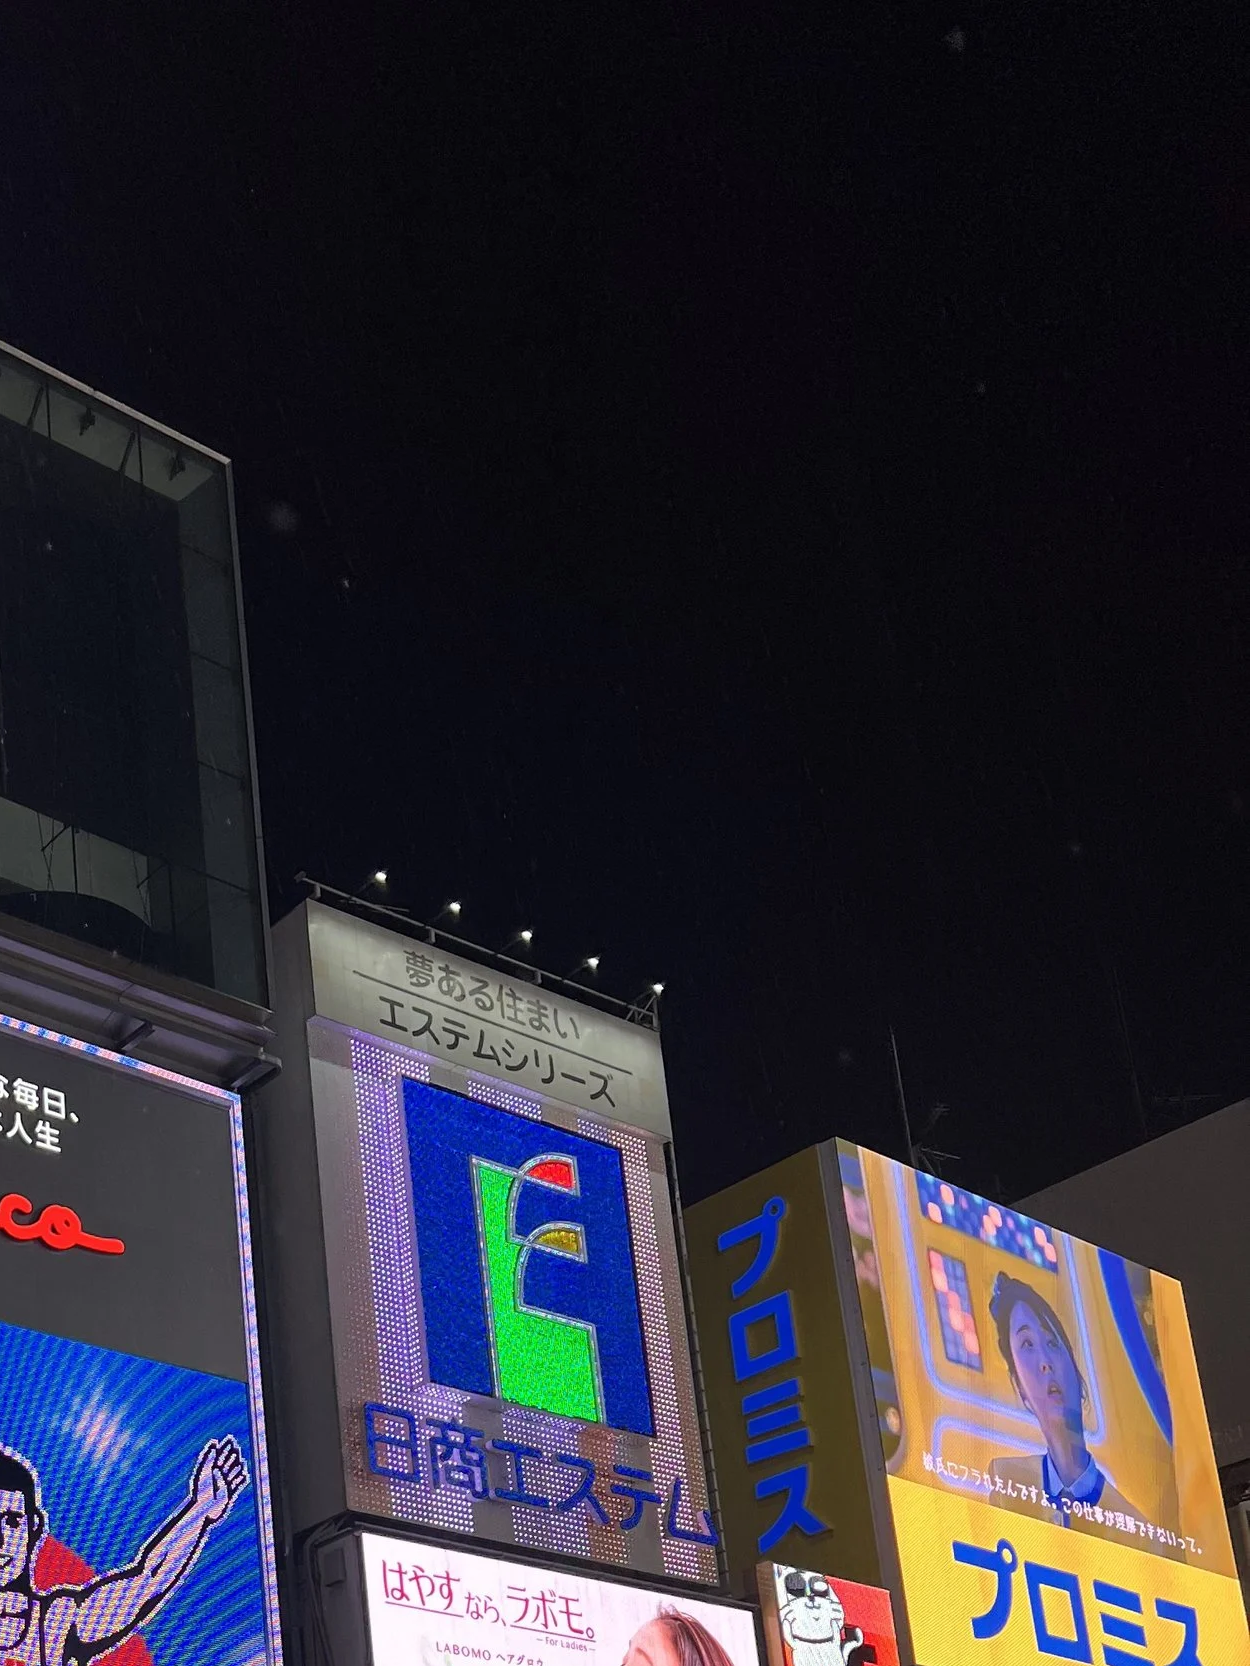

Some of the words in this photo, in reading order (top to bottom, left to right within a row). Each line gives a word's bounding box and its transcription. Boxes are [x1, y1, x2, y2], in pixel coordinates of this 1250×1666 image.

[378, 995, 617, 1108] エステムシリーズ
[403, 948, 580, 1042] 夢ある住まい
[716, 1195, 828, 1555] プロミス
[363, 1400, 719, 1548] 日商エステム
[436, 1641, 491, 1661] LABOMO
